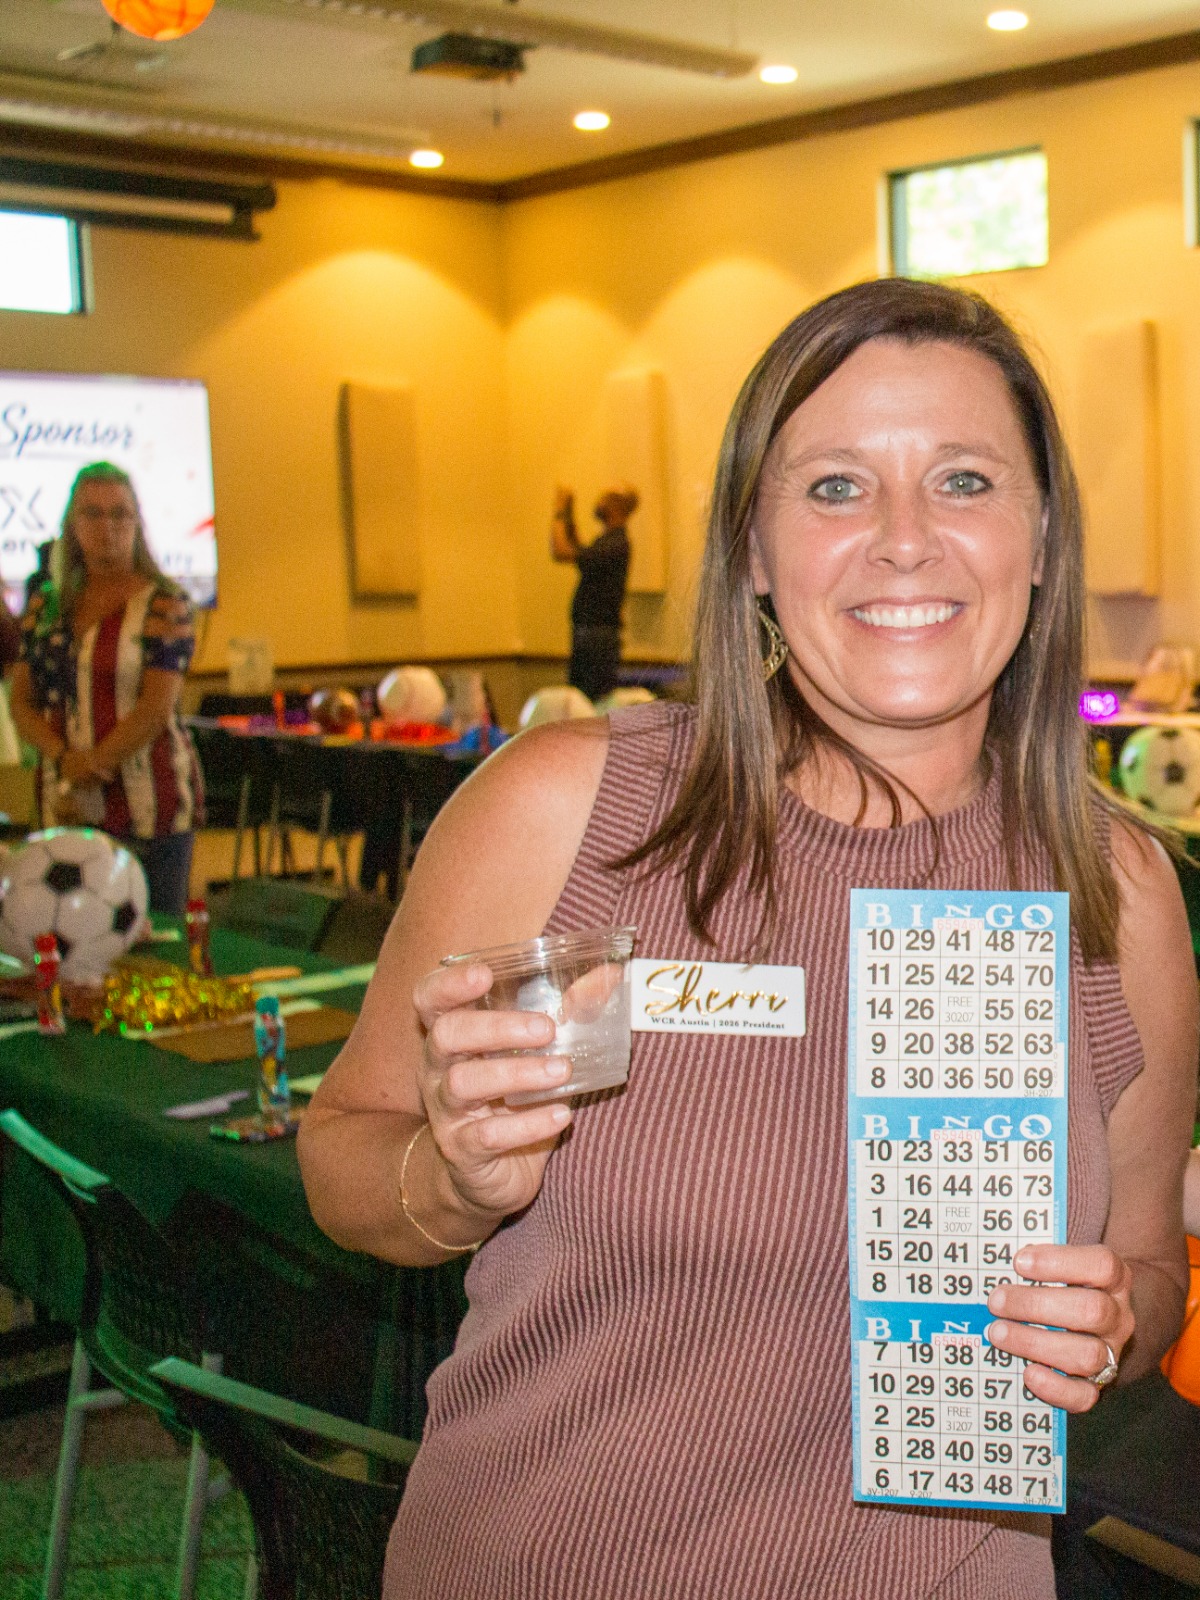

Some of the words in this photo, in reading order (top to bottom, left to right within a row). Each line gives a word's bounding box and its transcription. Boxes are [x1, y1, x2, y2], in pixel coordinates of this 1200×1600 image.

[0, 401, 134, 458] Sponsor
[867, 928, 894, 951] 10
[905, 929, 935, 951] 29
[946, 930, 970, 951] 41
[985, 929, 1015, 952] 48
[1025, 931, 1054, 952] 72
[867, 963, 890, 985] 11
[905, 963, 935, 986] 25
[945, 964, 974, 986] 42
[985, 965, 1015, 986] 54
[1024, 965, 1054, 987] 70
[866, 998, 893, 1020] 14
[904, 998, 934, 1020] 26
[984, 999, 1014, 1021] 55
[1024, 999, 1053, 1021] 62
[947, 997, 972, 1007] FREE
[651, 1016, 676, 1025] WCR
[679, 1018, 710, 1027] Austin
[742, 1022, 786, 1030] President
[945, 1013, 974, 1022] 30207
[871, 1032, 886, 1055] 9
[904, 1032, 934, 1055] 20
[944, 1033, 974, 1055] 38
[984, 1033, 1014, 1055] 52
[1024, 1033, 1053, 1055] 63
[870, 1067, 886, 1089] 8
[904, 1067, 934, 1089] 30
[944, 1067, 974, 1089] 36
[984, 1068, 1014, 1089] 50
[1024, 1069, 1053, 1089] 69
[865, 1139, 893, 1162] 10
[903, 1139, 933, 1163] 23
[943, 1141, 973, 1163] 33
[984, 1140, 1009, 1163] 51
[1023, 1140, 1053, 1163] 66
[870, 1173, 886, 1195] 3
[905, 1174, 932, 1197] 16
[942, 1175, 973, 1197] 44
[983, 1175, 1013, 1197] 46
[1023, 1175, 1052, 1197] 73
[871, 1206, 882, 1228] 1
[903, 1208, 933, 1230] 24
[983, 1210, 1013, 1232] 56
[1023, 1210, 1048, 1231] 61
[945, 1207, 970, 1217] FREE
[943, 1223, 972, 1232] 30707
[865, 1239, 893, 1261] 15
[903, 1241, 933, 1263] 20
[943, 1242, 968, 1264] 41
[982, 1243, 1013, 1265] 54
[872, 1272, 887, 1293] 8
[905, 1273, 933, 1295] 18
[943, 1274, 973, 1297] 39
[873, 1340, 889, 1361] 7
[906, 1341, 934, 1364] 19
[944, 1344, 974, 1366] 38
[984, 1346, 1012, 1367] 49
[868, 1372, 896, 1394] 10
[905, 1374, 935, 1396] 29
[944, 1376, 974, 1398] 36
[983, 1378, 1013, 1400] 57
[874, 1404, 890, 1426] 2
[905, 1406, 935, 1428] 25
[983, 1410, 1013, 1433] 58
[1022, 1412, 1053, 1434] 64
[947, 1407, 971, 1417] FREE
[946, 1422, 972, 1431] 31207
[874, 1436, 890, 1458] 8
[906, 1438, 936, 1460] 28
[944, 1440, 975, 1462] 40
[983, 1442, 1013, 1465] 59
[1022, 1444, 1052, 1467] 73
[875, 1468, 890, 1489] 6
[908, 1470, 935, 1491] 17
[944, 1472, 974, 1494] 43
[983, 1474, 1013, 1496] 48
[1022, 1476, 1048, 1498] 71
[1023, 1497, 1051, 1505] 3H-707
